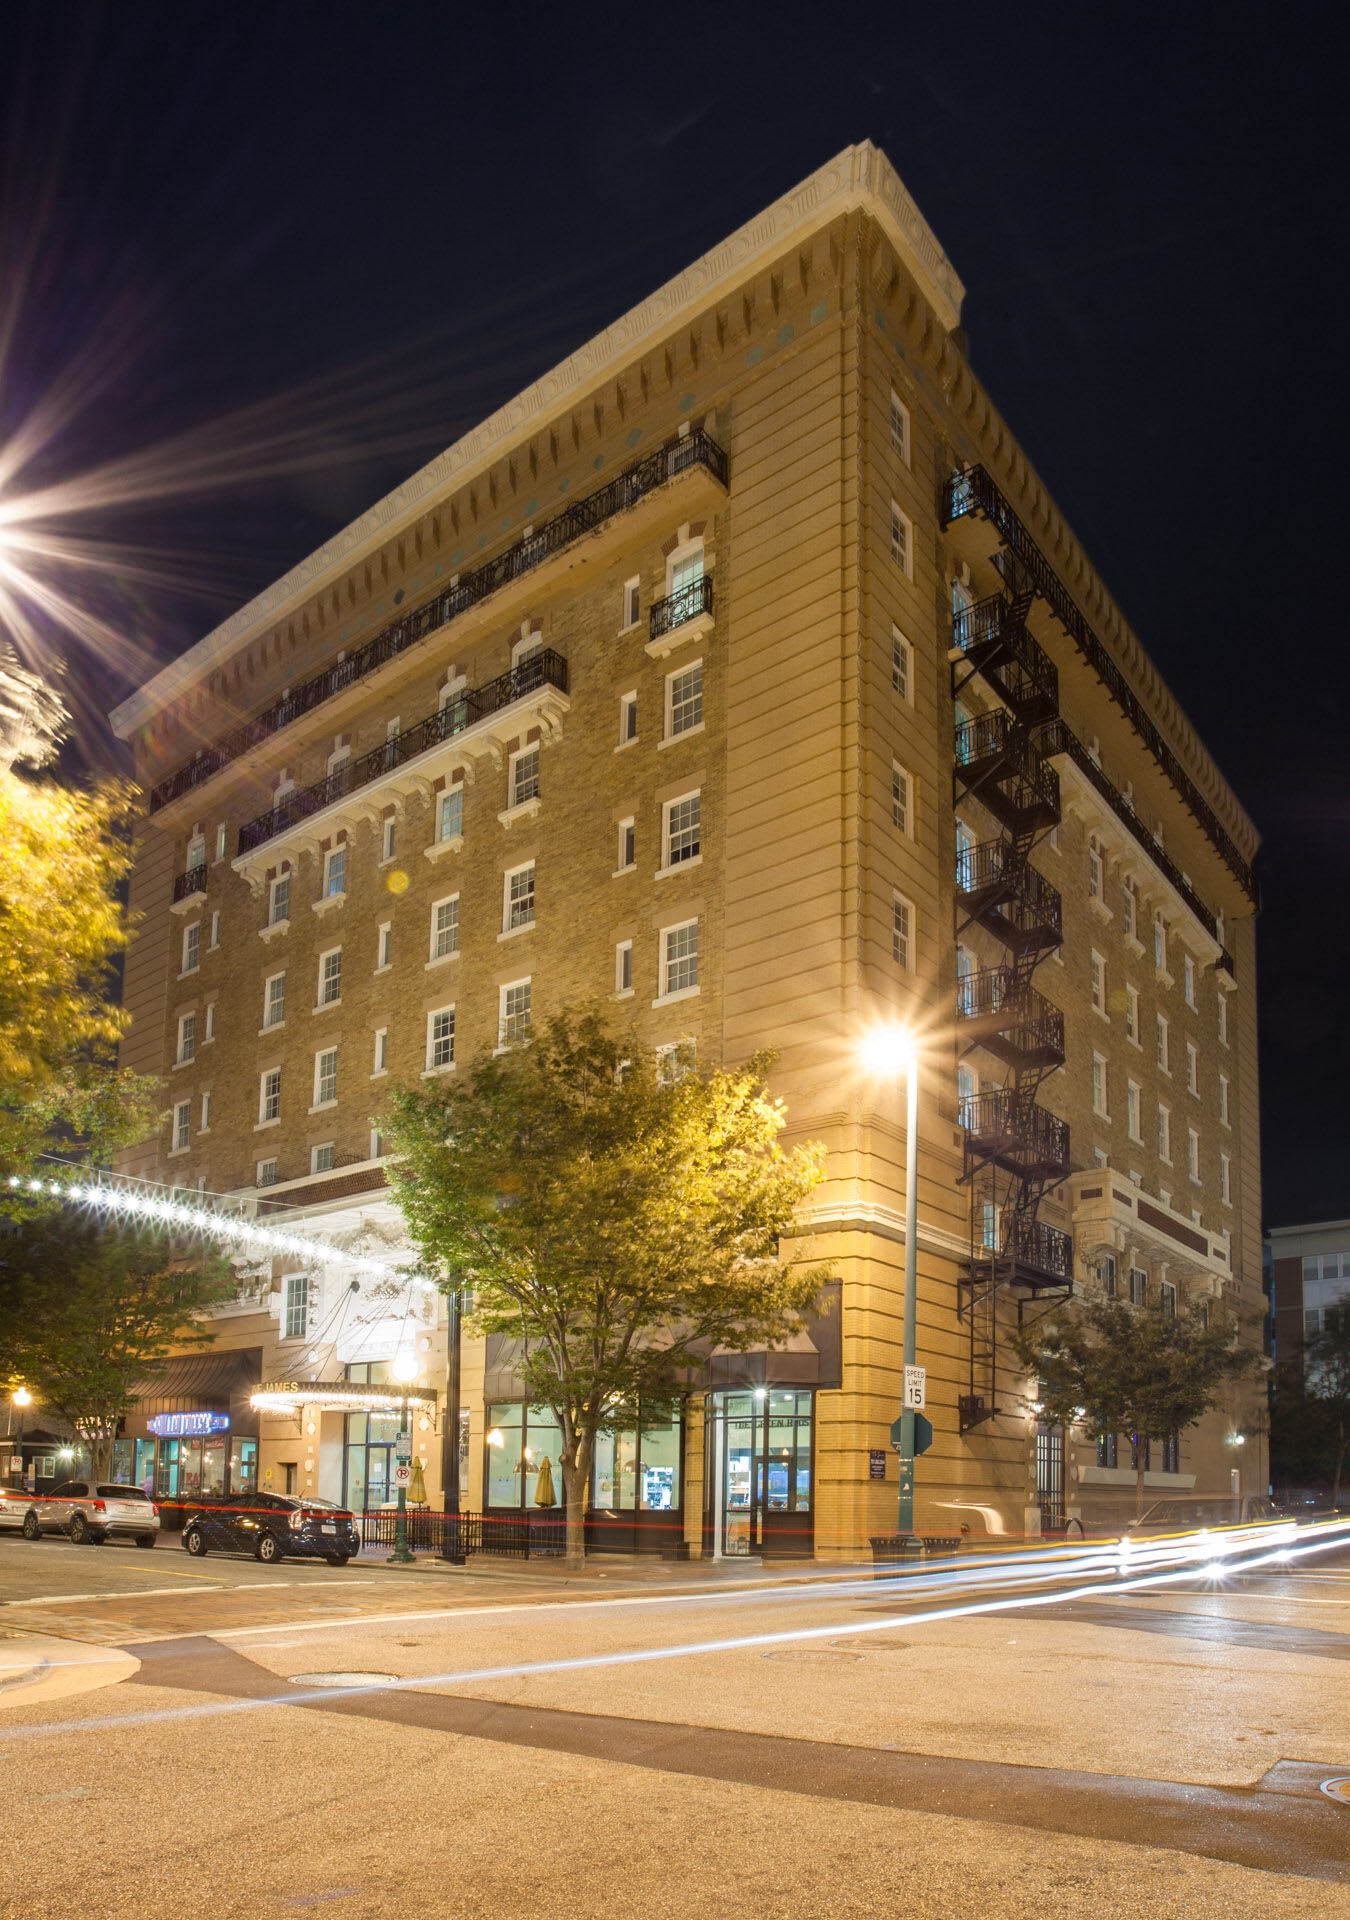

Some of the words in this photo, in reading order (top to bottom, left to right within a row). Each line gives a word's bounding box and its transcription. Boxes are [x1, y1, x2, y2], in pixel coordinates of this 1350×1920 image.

[906, 1370, 925, 1379] SPEED
[264, 1381, 299, 1394] JAMES
[909, 1388, 922, 1405] 15
